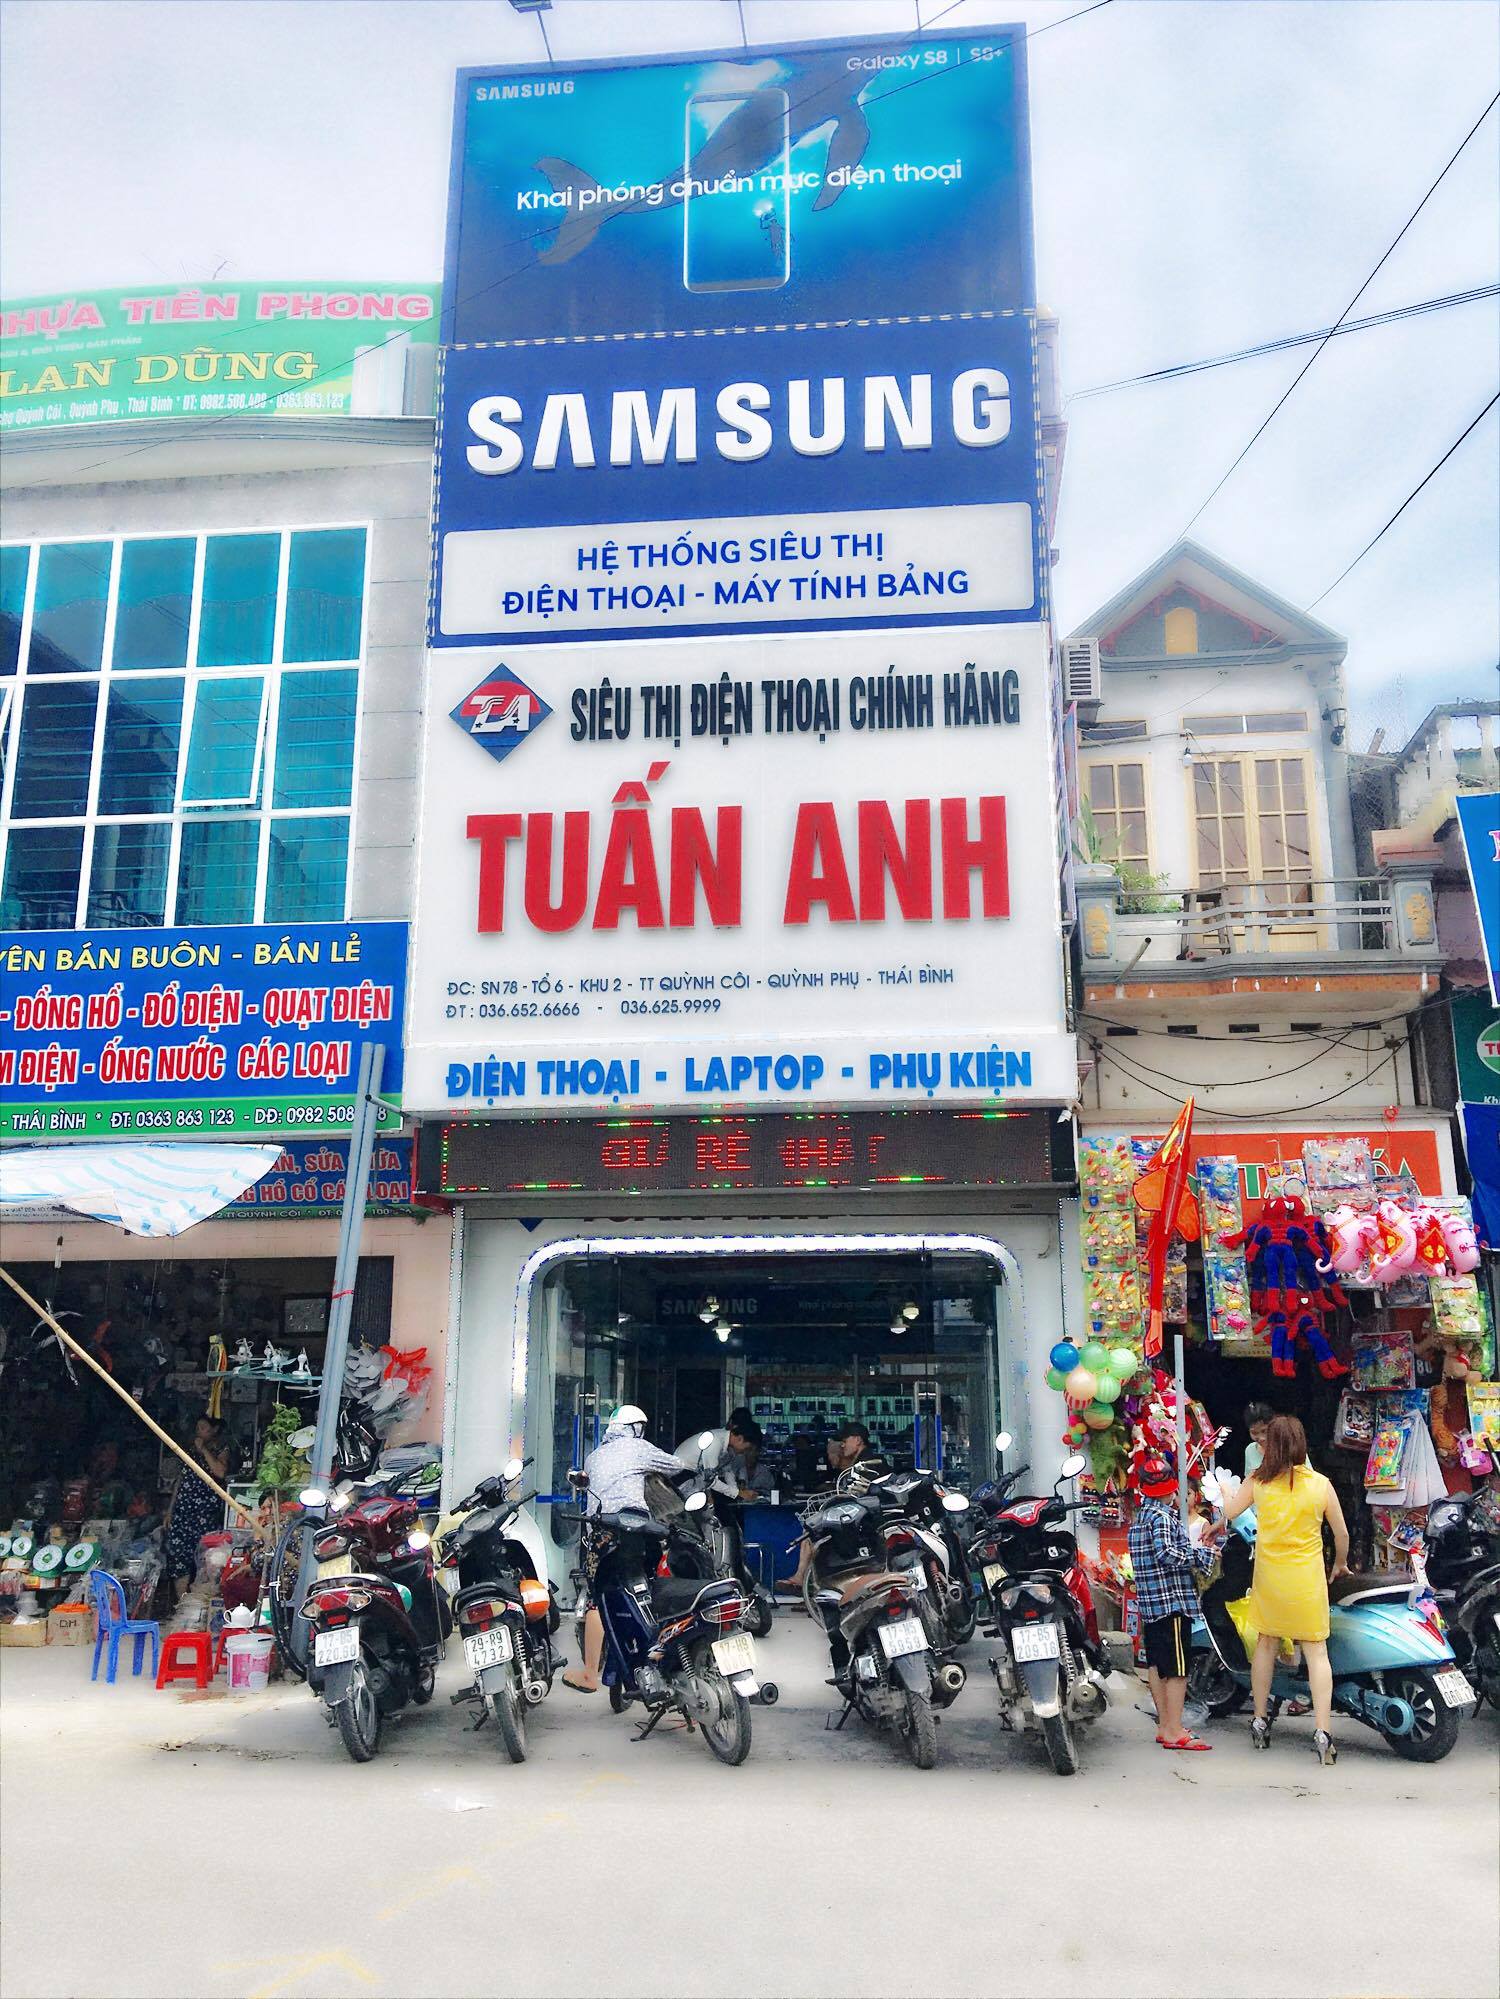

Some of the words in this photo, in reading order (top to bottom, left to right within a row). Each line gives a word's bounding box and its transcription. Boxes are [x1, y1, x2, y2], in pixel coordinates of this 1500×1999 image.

[846, 54, 920, 70] Galaxy
[924, 50, 947, 65] S8
[970, 46, 1003, 63] S8+
[476, 80, 575, 101] SAMSUNG
[516, 183, 572, 210] Khai
[579, 179, 663, 210] phóng
[669, 168, 754, 199] chuẩn
[760, 168, 819, 197] mực
[830, 163, 885, 189] điện
[892, 158, 962, 188] thoại
[121, 291, 239, 324] TIỀN
[257, 293, 432, 321] PHONG
[133, 345, 318, 384] DŨNG
[466, 368, 1012, 475] SAMSUNG
[577, 541, 620, 571] HỆ
[627, 530, 741, 568] THỐNG
[748, 536, 823, 562] SIÊU
[831, 532, 885, 563] THỊ
[502, 579, 579, 616] ĐIỆN
[586, 584, 685, 615] THOẠI
[714, 575, 782, 606] MÁY
[788, 569, 867, 601] TÍNH
[877, 563, 970, 598] BẢNG
[571, 677, 630, 742] SIÊU
[641, 682, 682, 749] THỊ
[690, 671, 752, 746] ĐIỆN
[761, 677, 840, 744] THOẠI
[850, 665, 934, 732] CHÍNH
[943, 662, 1020, 726] HÃNG
[466, 761, 743, 934] TUẤN
[783, 795, 1011, 924] ANH
[56, 941, 121, 972] BÁN
[131, 941, 221, 970] BUÔN
[253, 936, 319, 965] BÁN
[331, 933, 361, 963] LẺ
[447, 981, 475, 995] ĐC:
[531, 972, 551, 994] TỔ
[554, 979, 564, 993] 6
[580, 978, 609, 992] KHU
[613, 977, 622, 991] 2
[640, 977, 654, 991] TT
[659, 971, 714, 992] QUỲNH
[720, 971, 750, 989] CÔI
[767, 968, 824, 988] QUỲNH
[830, 971, 859, 989] PHỤ
[878, 965, 912, 984] THÁI
[919, 963, 954, 983] BÌNH
[15, 984, 82, 1029] ĐỒNG
[88, 983, 122, 1029] HỒ
[143, 981, 178, 1027] ĐỒ
[183, 985, 240, 1031] ĐIỆN
[263, 990, 326, 1029] QUẠT
[331, 979, 392, 1028] ĐIỆN
[479, 1002, 580, 1018] 036.652.6666
[620, 999, 721, 1014] 036.625.9999
[20, 1044, 77, 1092] ĐIỆN
[100, 1035, 150, 1083] ỐNG
[157, 1036, 225, 1081] NƯỚC
[238, 1034, 290, 1079] CÁC
[294, 1042, 350, 1084] LOẠI
[446, 1054, 526, 1106] ĐIỆN
[537, 1059, 640, 1103] THOẠI
[685, 1055, 825, 1093] LAPTOP
[870, 1052, 941, 1098] PHỤ
[949, 1044, 1032, 1097] KIỆN
[12, 1109, 46, 1130] THÁI
[49, 1107, 86, 1130] BÌNH
[110, 1111, 131, 1128] ĐT:
[135, 1110, 171, 1127] 0363
[176, 1109, 203, 1126] 863
[209, 1109, 235, 1125] 123
[254, 1107, 282, 1124] DĐ:
[286, 1106, 323, 1123] 0982
[304, 1147, 344, 1171] SỬA
[260, 1178, 287, 1203] HỒ
[291, 1177, 318, 1202] CỐ
[237, 1208, 276, 1218] QUỲNH
[471, 1631, 503, 1652] 29-R9
[1017, 1641, 1057, 1660] 209.16
[1019, 1627, 1050, 1644] 17-B5
[474, 1646, 505, 1666] 4732
